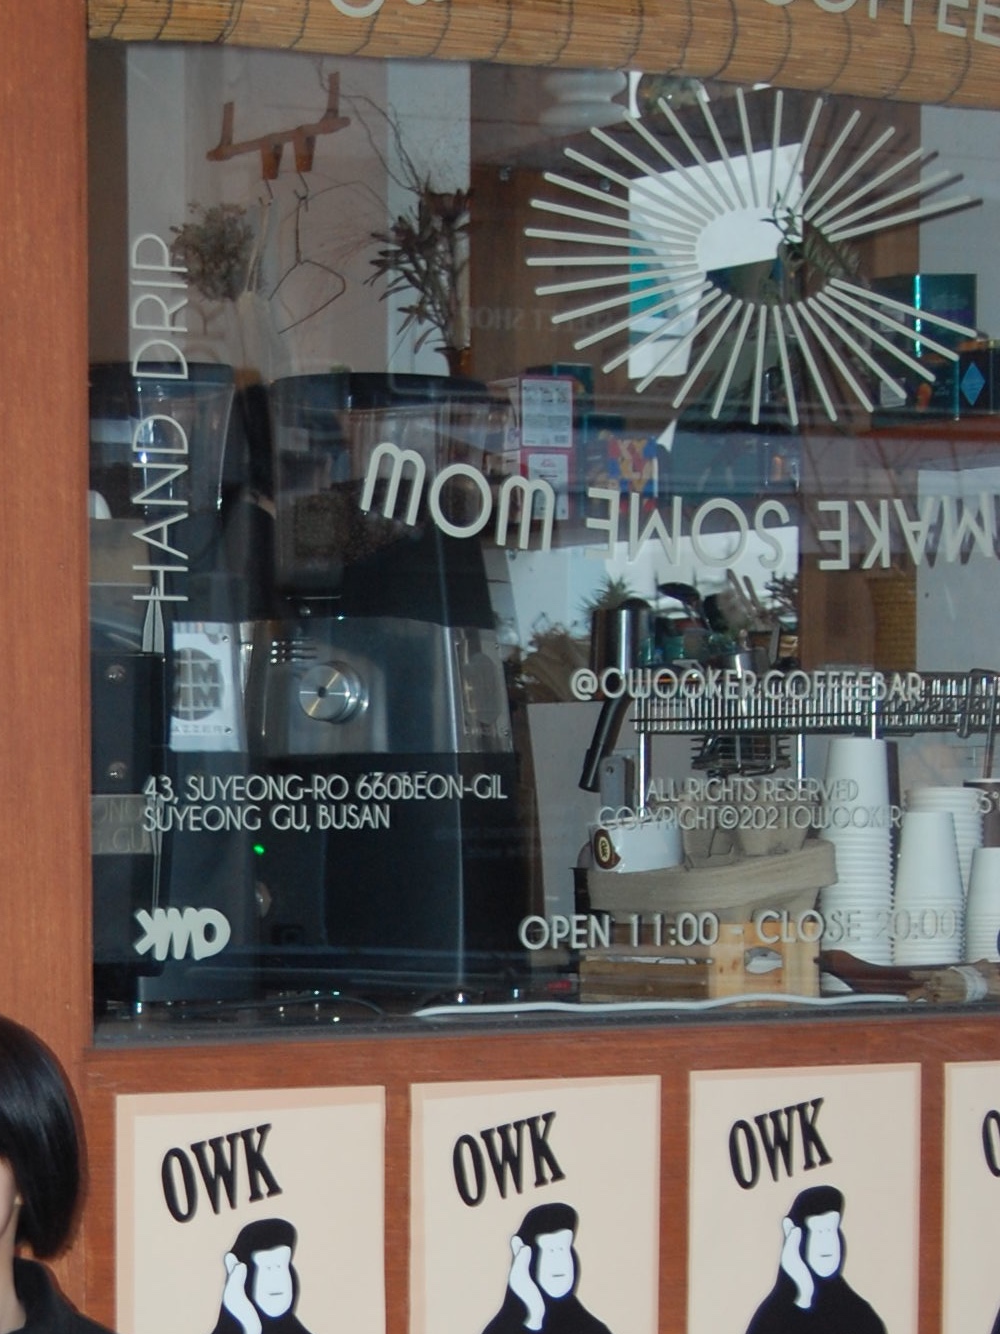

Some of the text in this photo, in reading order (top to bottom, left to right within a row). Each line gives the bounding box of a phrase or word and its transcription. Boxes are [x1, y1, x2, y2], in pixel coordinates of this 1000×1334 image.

[132, 233, 189, 602] HAND DRIP
[585, 486, 790, 569] SOME
[818, 493, 996, 570] MAKE
[143, 803, 392, 833] SUYEONG GU, BUSAN
[144, 773, 508, 804] 43, SUYEONG-RO 660BEON-GIL
[646, 777, 860, 803] ALL RIGHTS RESERVED
[518, 911, 612, 953] OPEN
[629, 911, 720, 947] 11:00
[755, 908, 863, 944] CLOSE
[873, 907, 958, 943] 20:00
[160, 1122, 284, 1224] OWK
[451, 1110, 567, 1208] OWK
[727, 1097, 834, 1191] OWK
